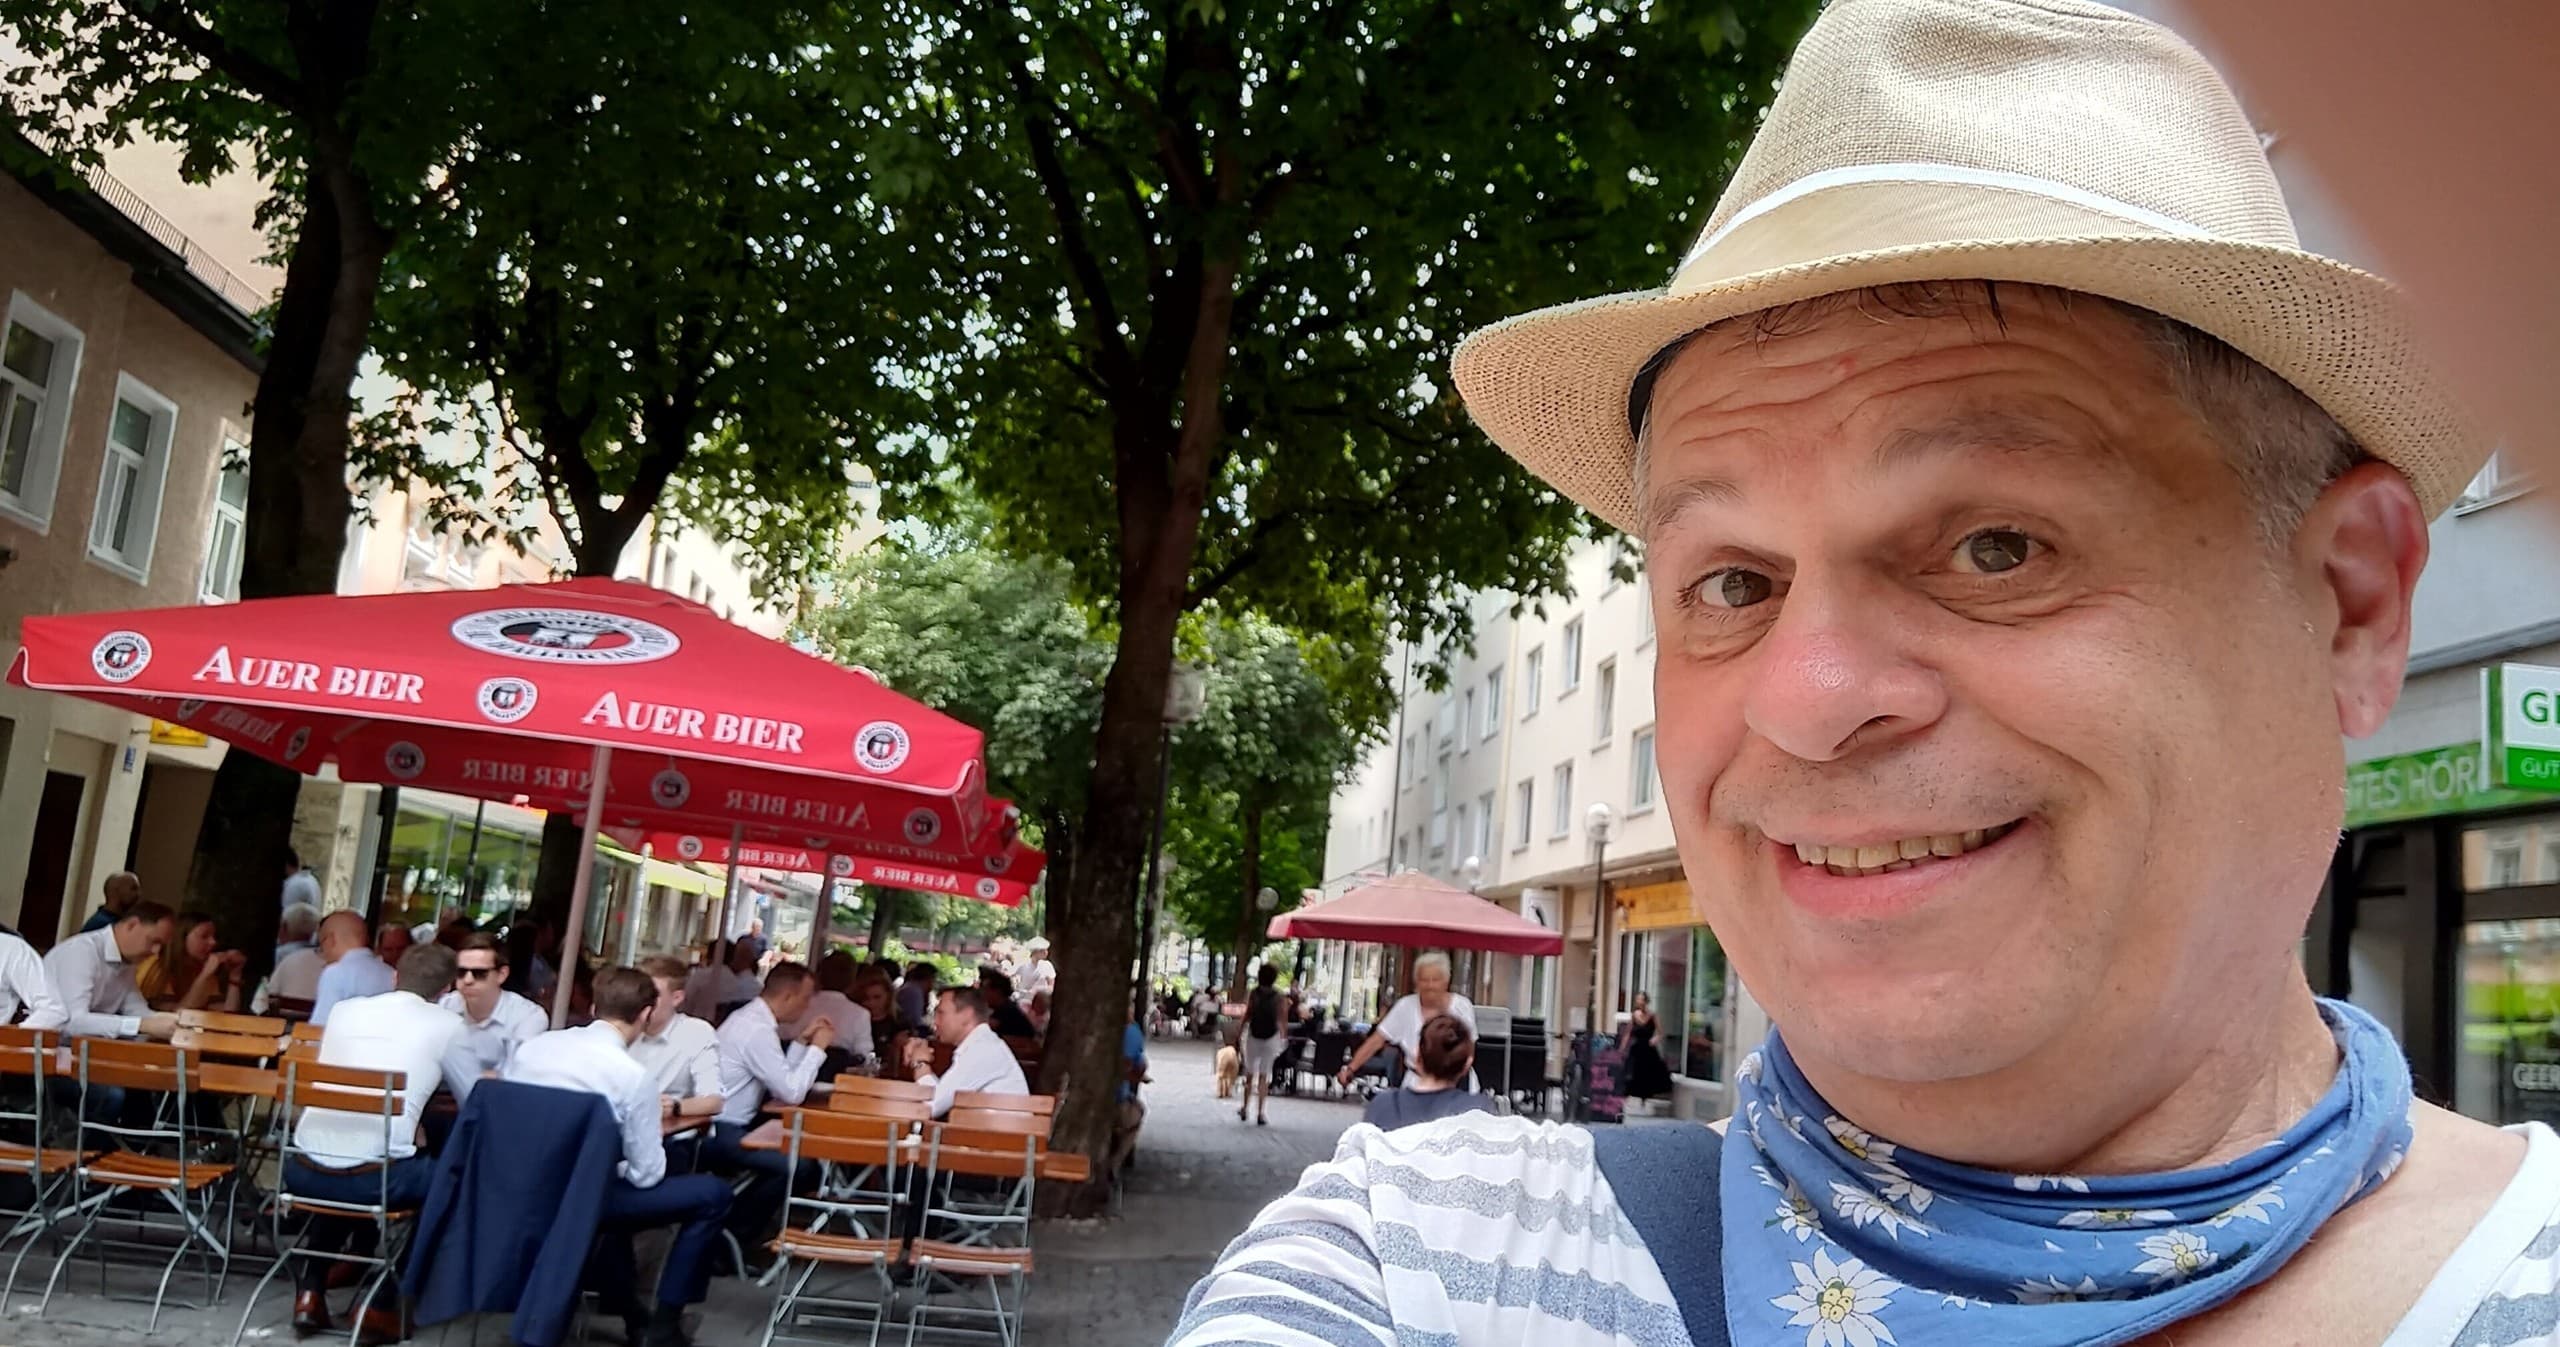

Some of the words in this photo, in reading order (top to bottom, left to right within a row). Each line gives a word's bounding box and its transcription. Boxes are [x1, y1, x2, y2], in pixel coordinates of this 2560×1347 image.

[192, 645, 321, 693] AUER
[327, 665, 425, 703] BIER
[581, 690, 706, 739] AUER
[712, 711, 805, 754] BIER
[2346, 766, 2400, 809] TES
[2408, 752, 2477, 804] HÖR
